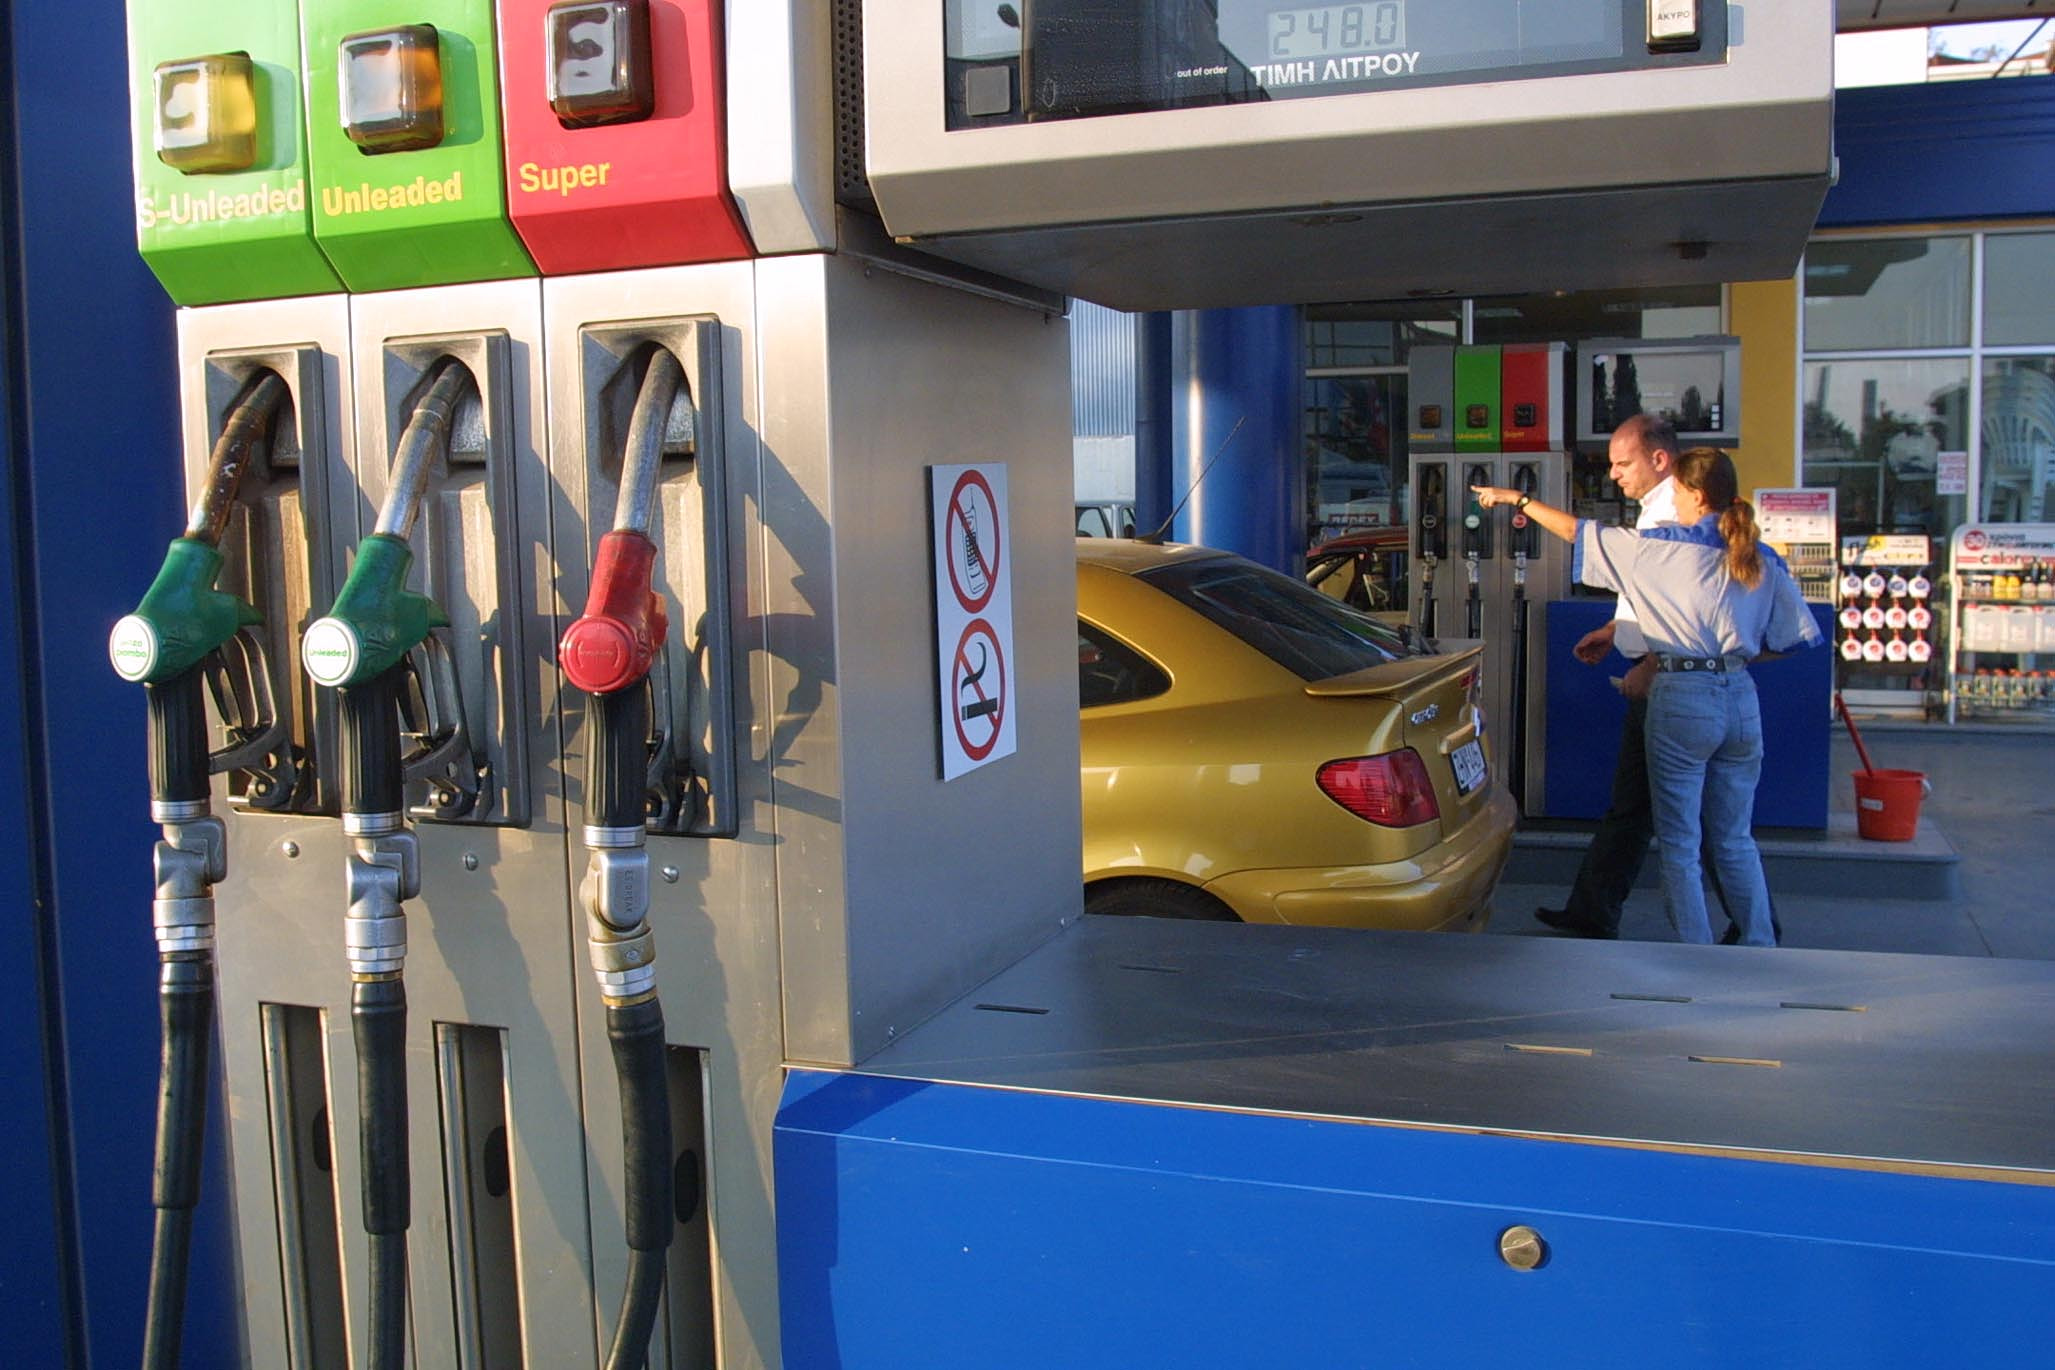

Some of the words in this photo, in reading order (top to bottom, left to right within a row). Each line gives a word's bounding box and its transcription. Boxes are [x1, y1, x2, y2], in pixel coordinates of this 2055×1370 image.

[1273, 3, 1398, 55] 248.0
[1177, 69, 1192, 78] out
[1193, 66, 1203, 77] of
[1203, 65, 1228, 76] order
[1250, 59, 1315, 87] ΤΙΜΗ
[1322, 51, 1421, 81] ΛΙΤΡΟΥ
[321, 170, 463, 217] Unleaded
[518, 161, 611, 197] Super
[139, 177, 306, 229] S-Unleaded
